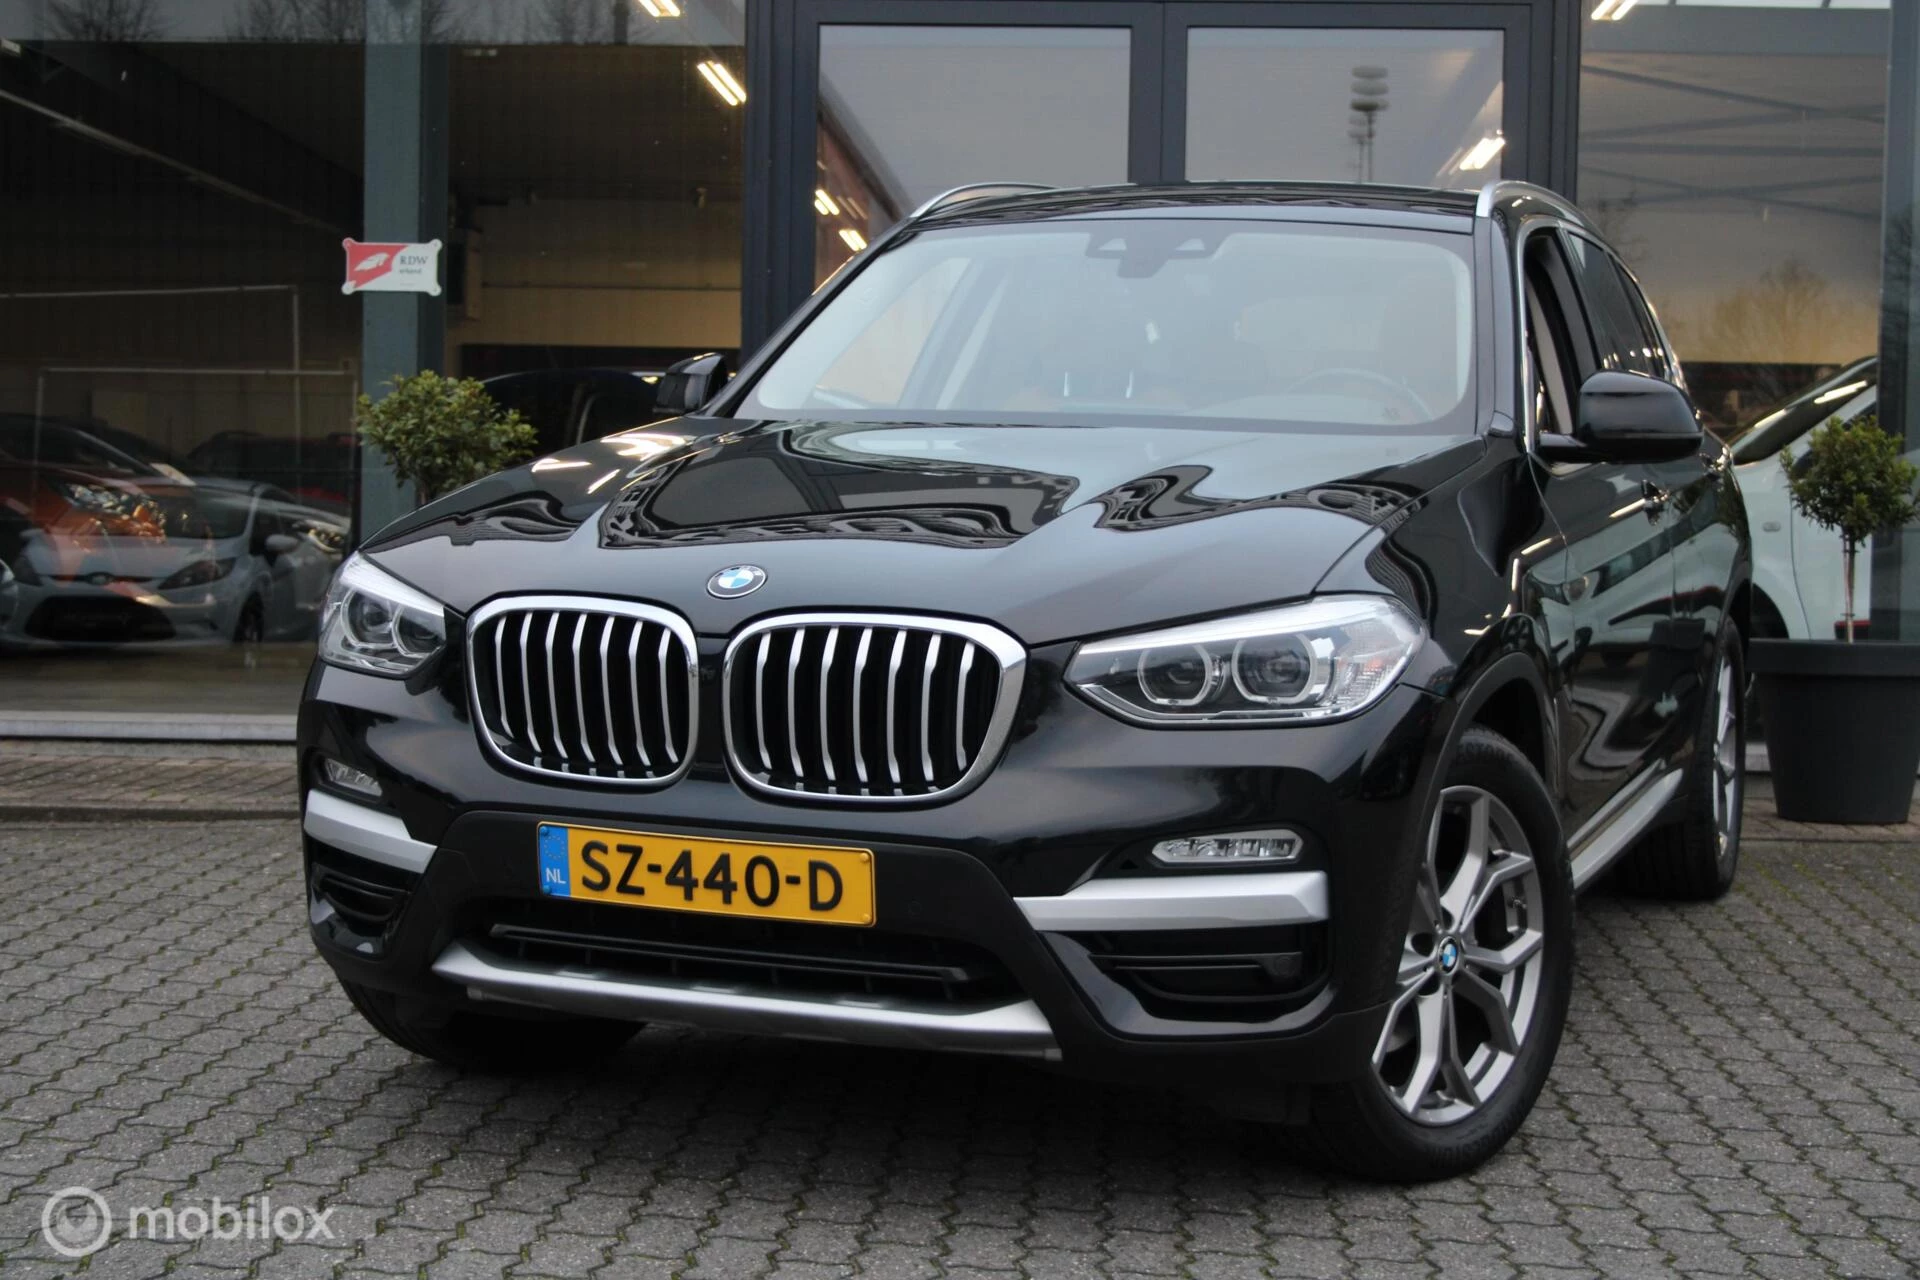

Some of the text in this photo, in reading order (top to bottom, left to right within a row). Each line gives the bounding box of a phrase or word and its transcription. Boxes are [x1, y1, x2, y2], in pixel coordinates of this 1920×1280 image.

[399, 255, 429, 265] RDW
[545, 867, 567, 885] NL
[581, 840, 843, 912] SZ-440-D
